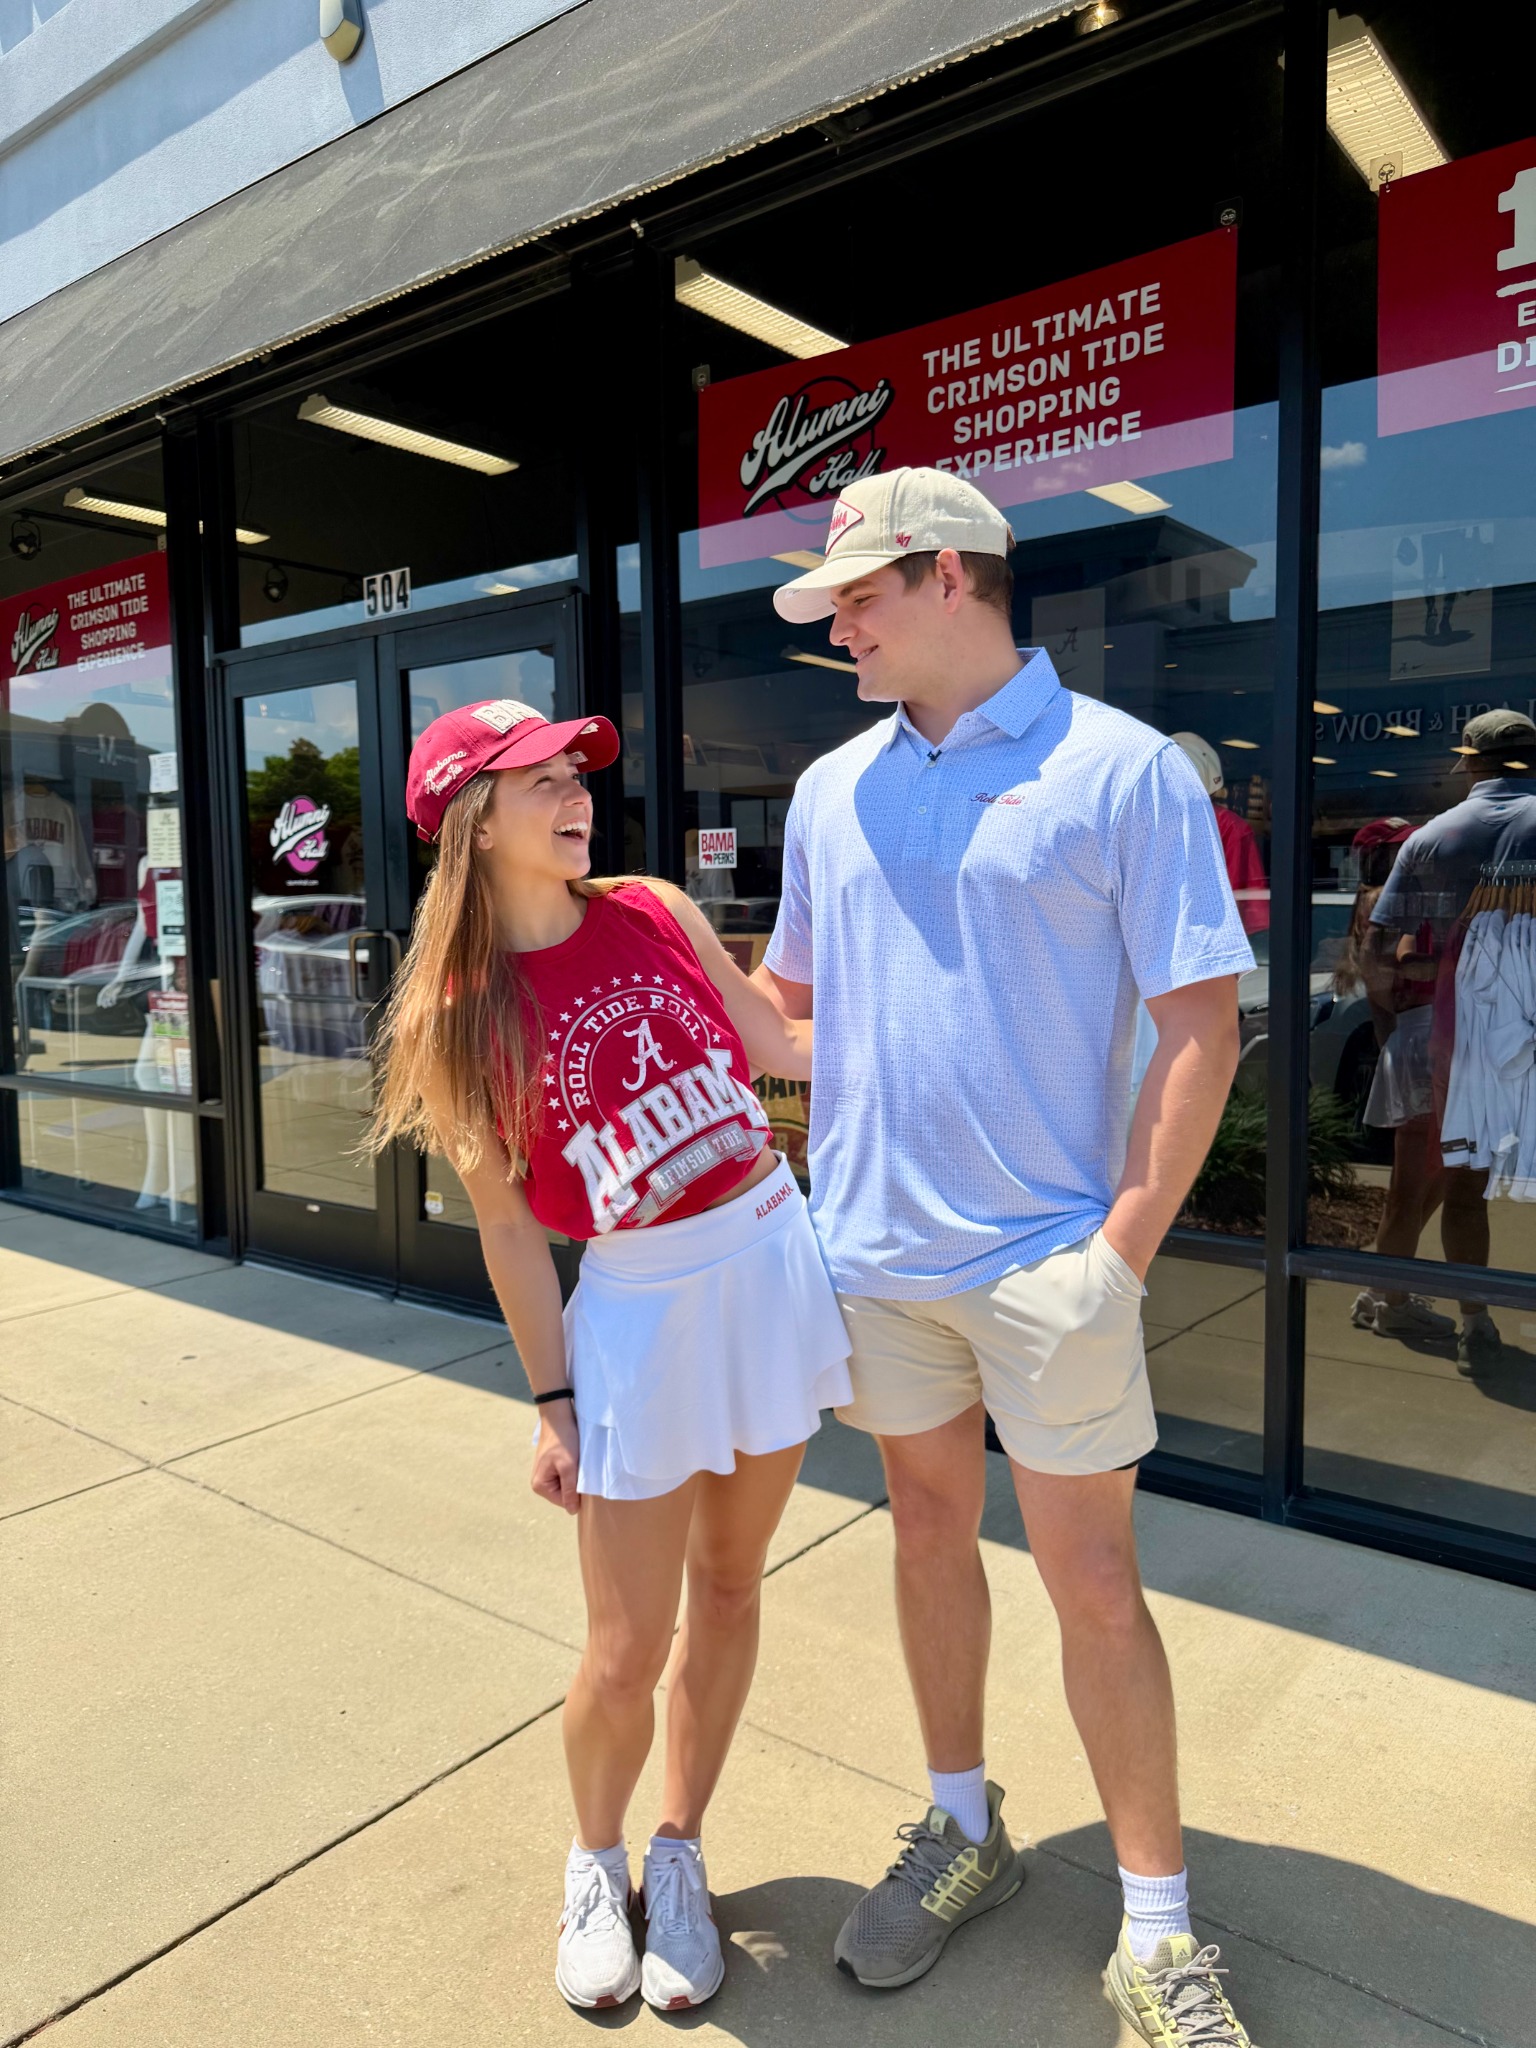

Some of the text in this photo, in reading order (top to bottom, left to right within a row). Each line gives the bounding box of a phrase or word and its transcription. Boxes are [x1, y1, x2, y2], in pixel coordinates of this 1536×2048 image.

[922, 281, 1161, 378] THE ULTIMATE
[927, 322, 1164, 414] CRIMSON TIDE
[953, 376, 1121, 444] SHOPPING
[740, 379, 889, 486] Alumni
[935, 410, 1142, 479] EXPERIENCE
[809, 449, 882, 493] Hall
[67, 573, 146, 610] THE ULTIMATE
[70, 596, 149, 631] CRIMSON TIDE
[366, 568, 409, 616] 504
[11, 608, 60, 663] Alumni
[77, 642, 146, 673] EXPERIENCE
[81, 621, 137, 650] SHOPPING
[424, 751, 467, 795] Alabama
[970, 792, 1000, 803] Roll
[270, 802, 330, 847] Alumni
[701, 832, 734, 852] BAMA
[298, 839, 329, 859] Hall
[713, 852, 735, 864] PERKS
[568, 994, 701, 1110] ROLL TIDE ROLL
[561, 1048, 770, 1234] ALABAMA
[656, 1143, 716, 1191] CRIMSON
[711, 1130, 743, 1155] TIDE
[755, 1182, 794, 1220] ALABAMA
